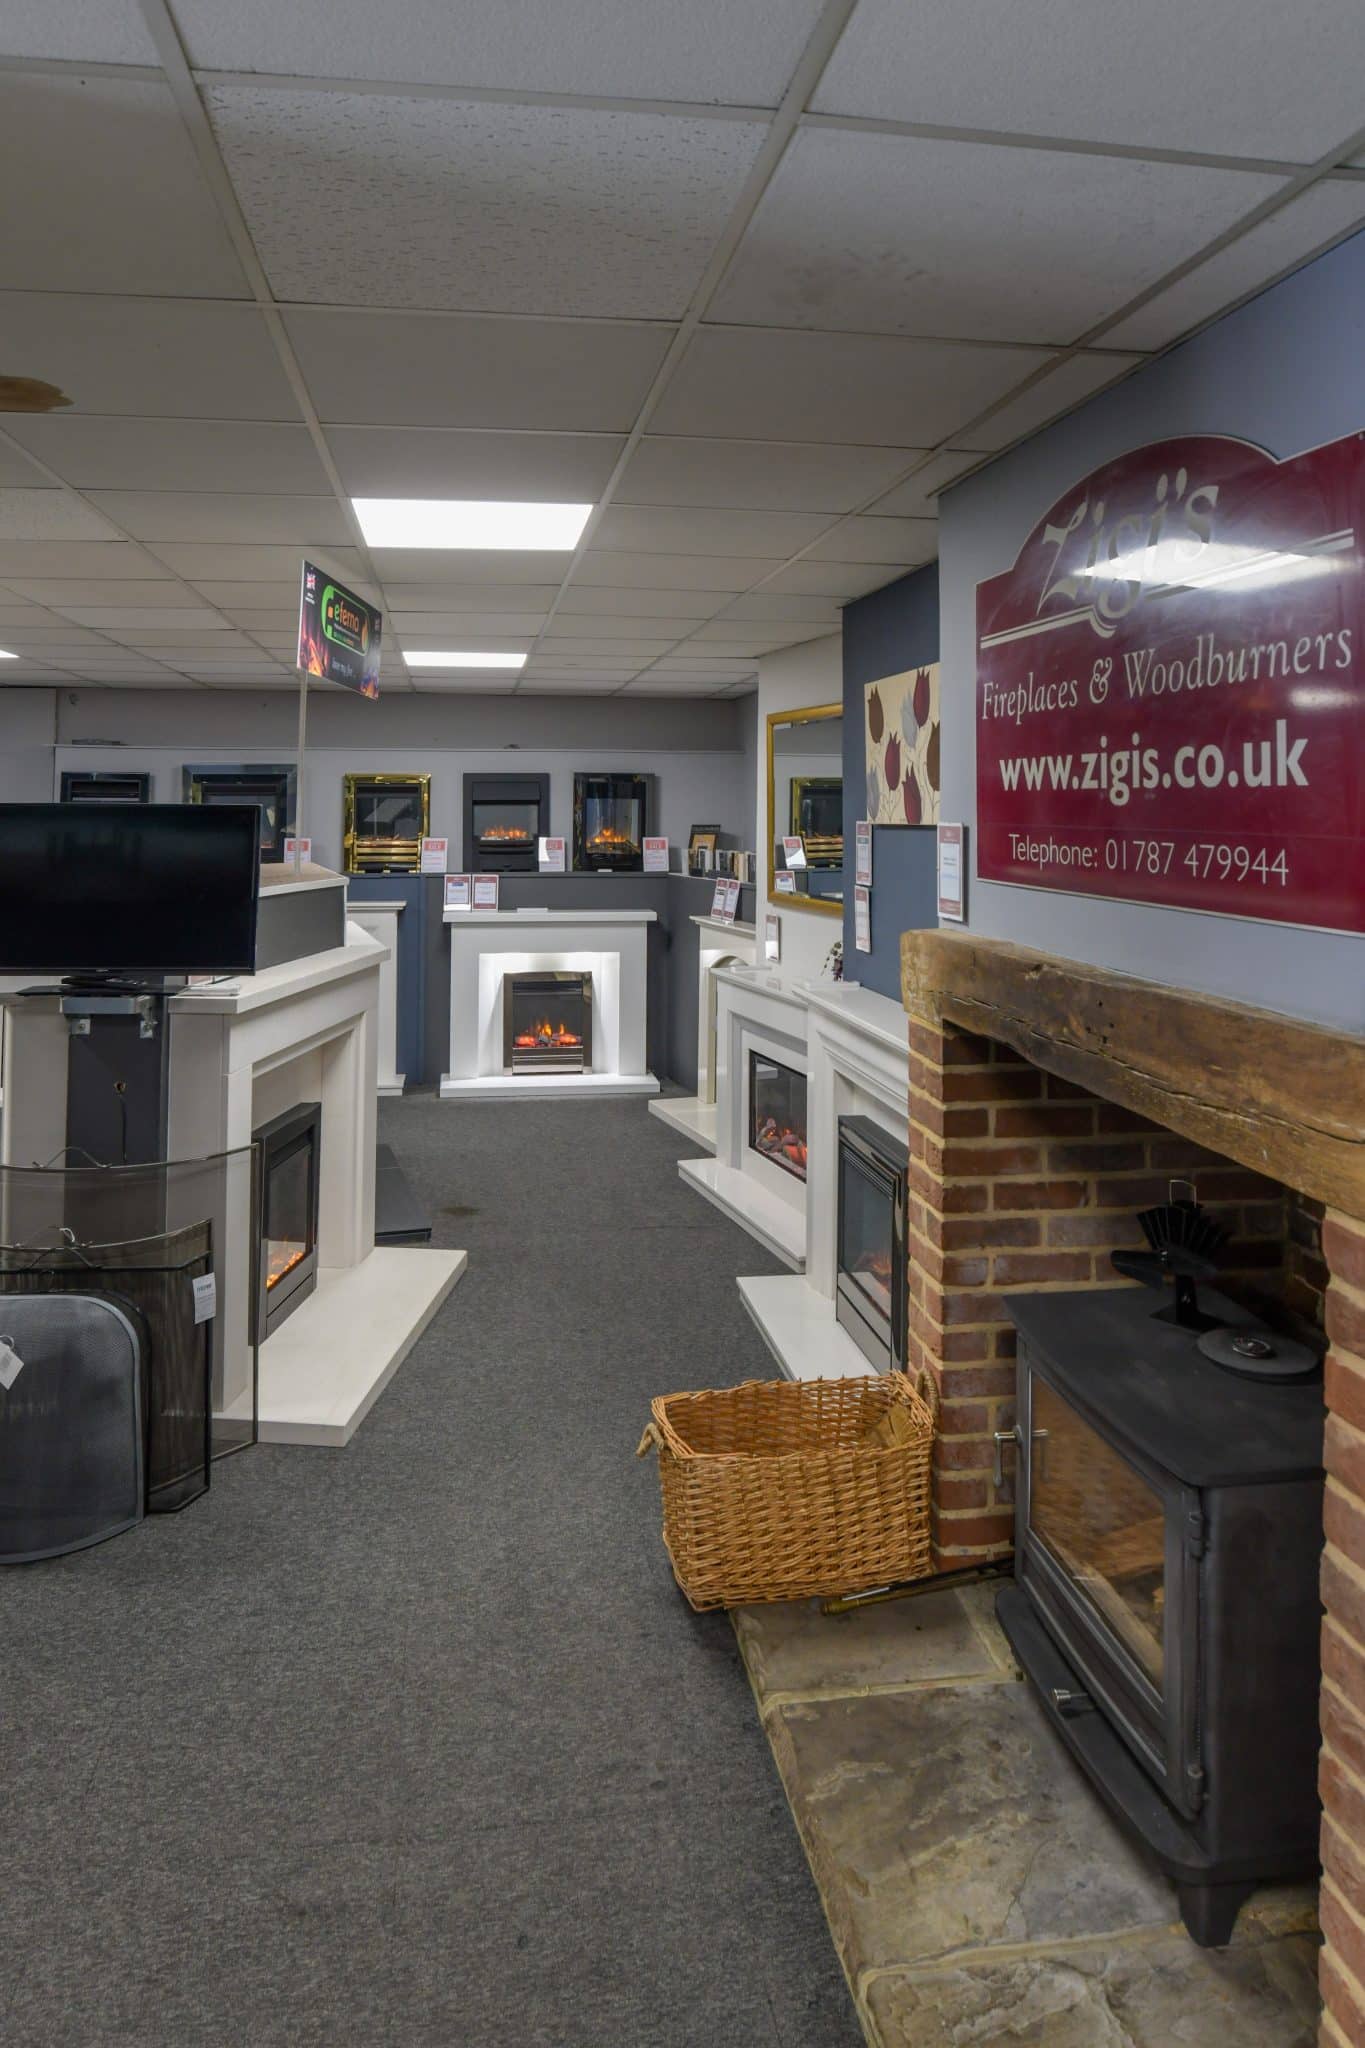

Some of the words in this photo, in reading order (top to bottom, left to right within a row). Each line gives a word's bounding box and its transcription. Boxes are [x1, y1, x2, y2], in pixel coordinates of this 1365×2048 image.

[1036, 467, 1219, 618] Zigi's
[982, 678, 1078, 724] Fireplaces
[1089, 658, 1113, 704] &
[1122, 628, 1352, 699] Woodburners
[999, 719, 1309, 806] www.zigis.co.uk
[1008, 833, 1097, 869] Telephone:
[1105, 839, 1174, 874] 01787
[1184, 844, 1289, 885] 479944
